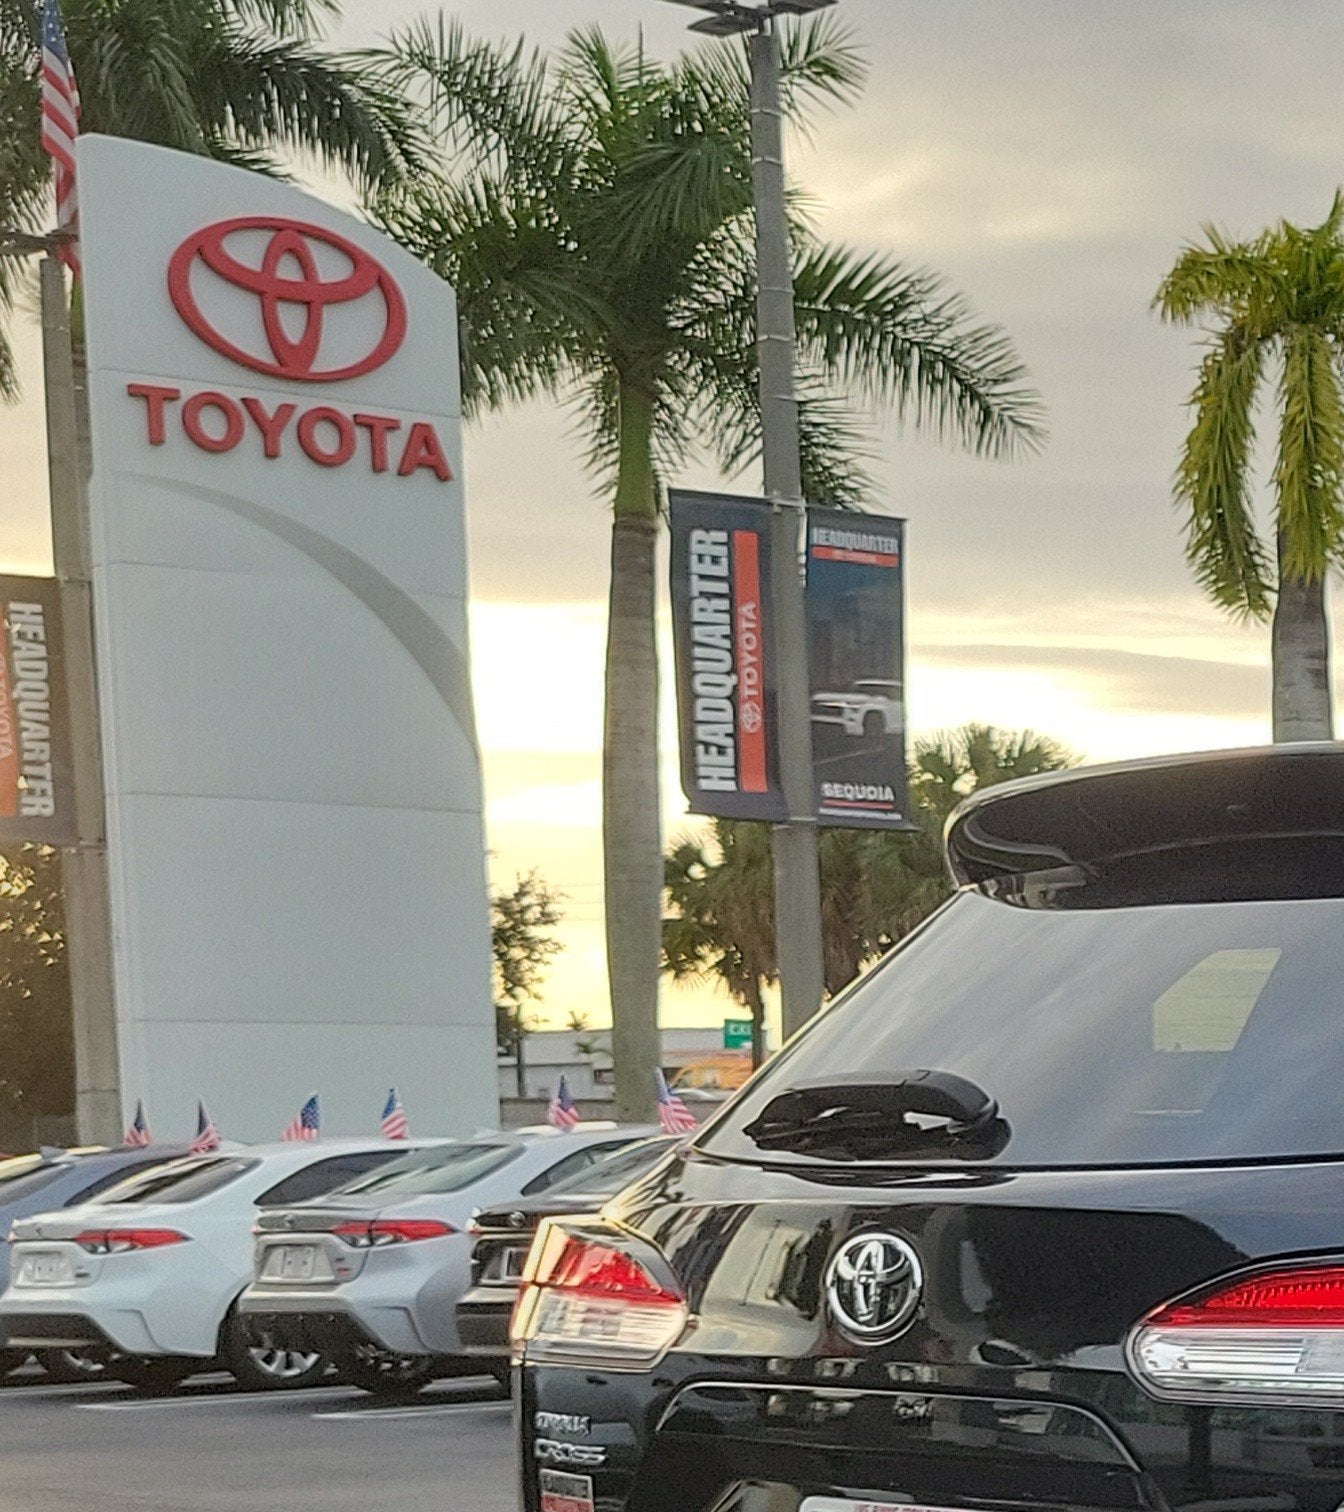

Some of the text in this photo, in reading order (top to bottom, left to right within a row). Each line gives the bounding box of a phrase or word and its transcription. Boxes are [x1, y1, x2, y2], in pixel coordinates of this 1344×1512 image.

[127, 384, 452, 482] TOYOTA
[690, 529, 738, 791] HEADQUARTER
[738, 602, 760, 697] TOYOTA
[9, 602, 55, 817] HEADQUARTER
[822, 782, 895, 801] SEQUOIA
